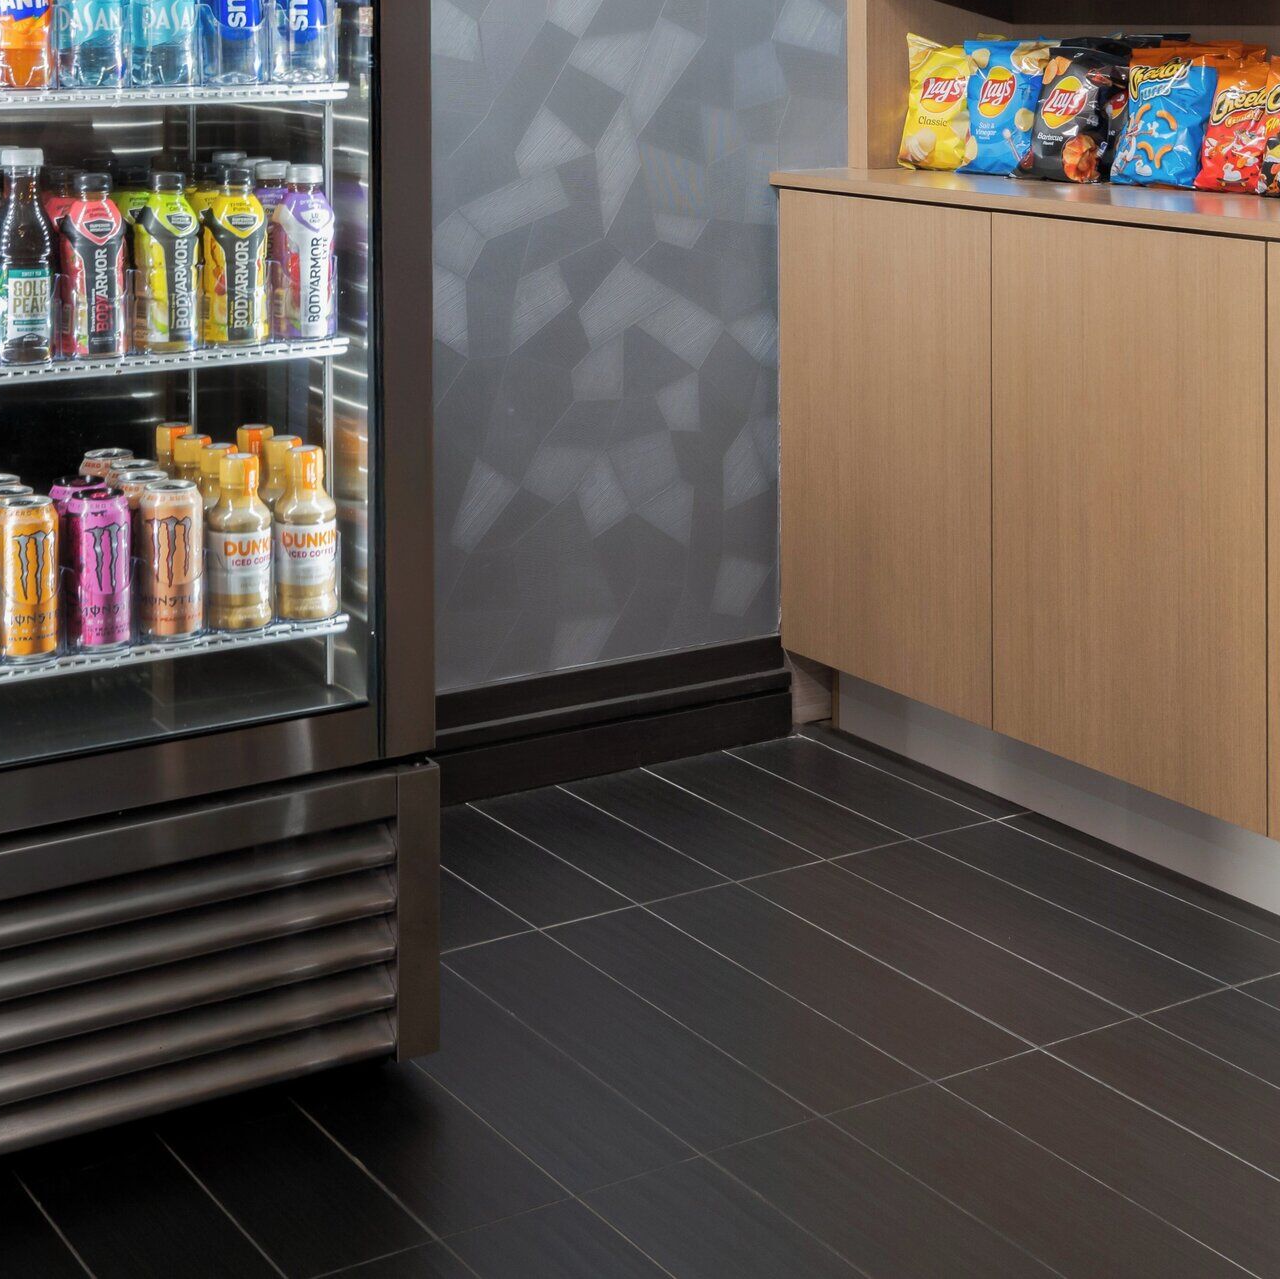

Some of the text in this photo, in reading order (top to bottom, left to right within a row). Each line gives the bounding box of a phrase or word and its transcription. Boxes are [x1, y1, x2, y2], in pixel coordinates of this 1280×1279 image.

[59, 0, 121, 39] DASAN
[922, 78, 962, 103] Lay's
[981, 79, 1011, 106] Lay's
[1130, 58, 1193, 102] Cheetos
[1044, 89, 1080, 116] Lay's
[918, 116, 947, 127] Classic
[975, 128, 996, 137] Vinegar
[1037, 132, 1063, 142] Barbecue
[14, 280, 48, 296] GOLD
[96, 248, 108, 333] BODYARMOR
[176, 239, 188, 329] BODYARMOR
[233, 241, 250, 329] BODYARMOR
[308, 237, 323, 323] BODYARMOR
[13, 297, 48, 314] PEAK
[231, 558, 252, 567] ICED
[289, 550, 308, 559] ICED
